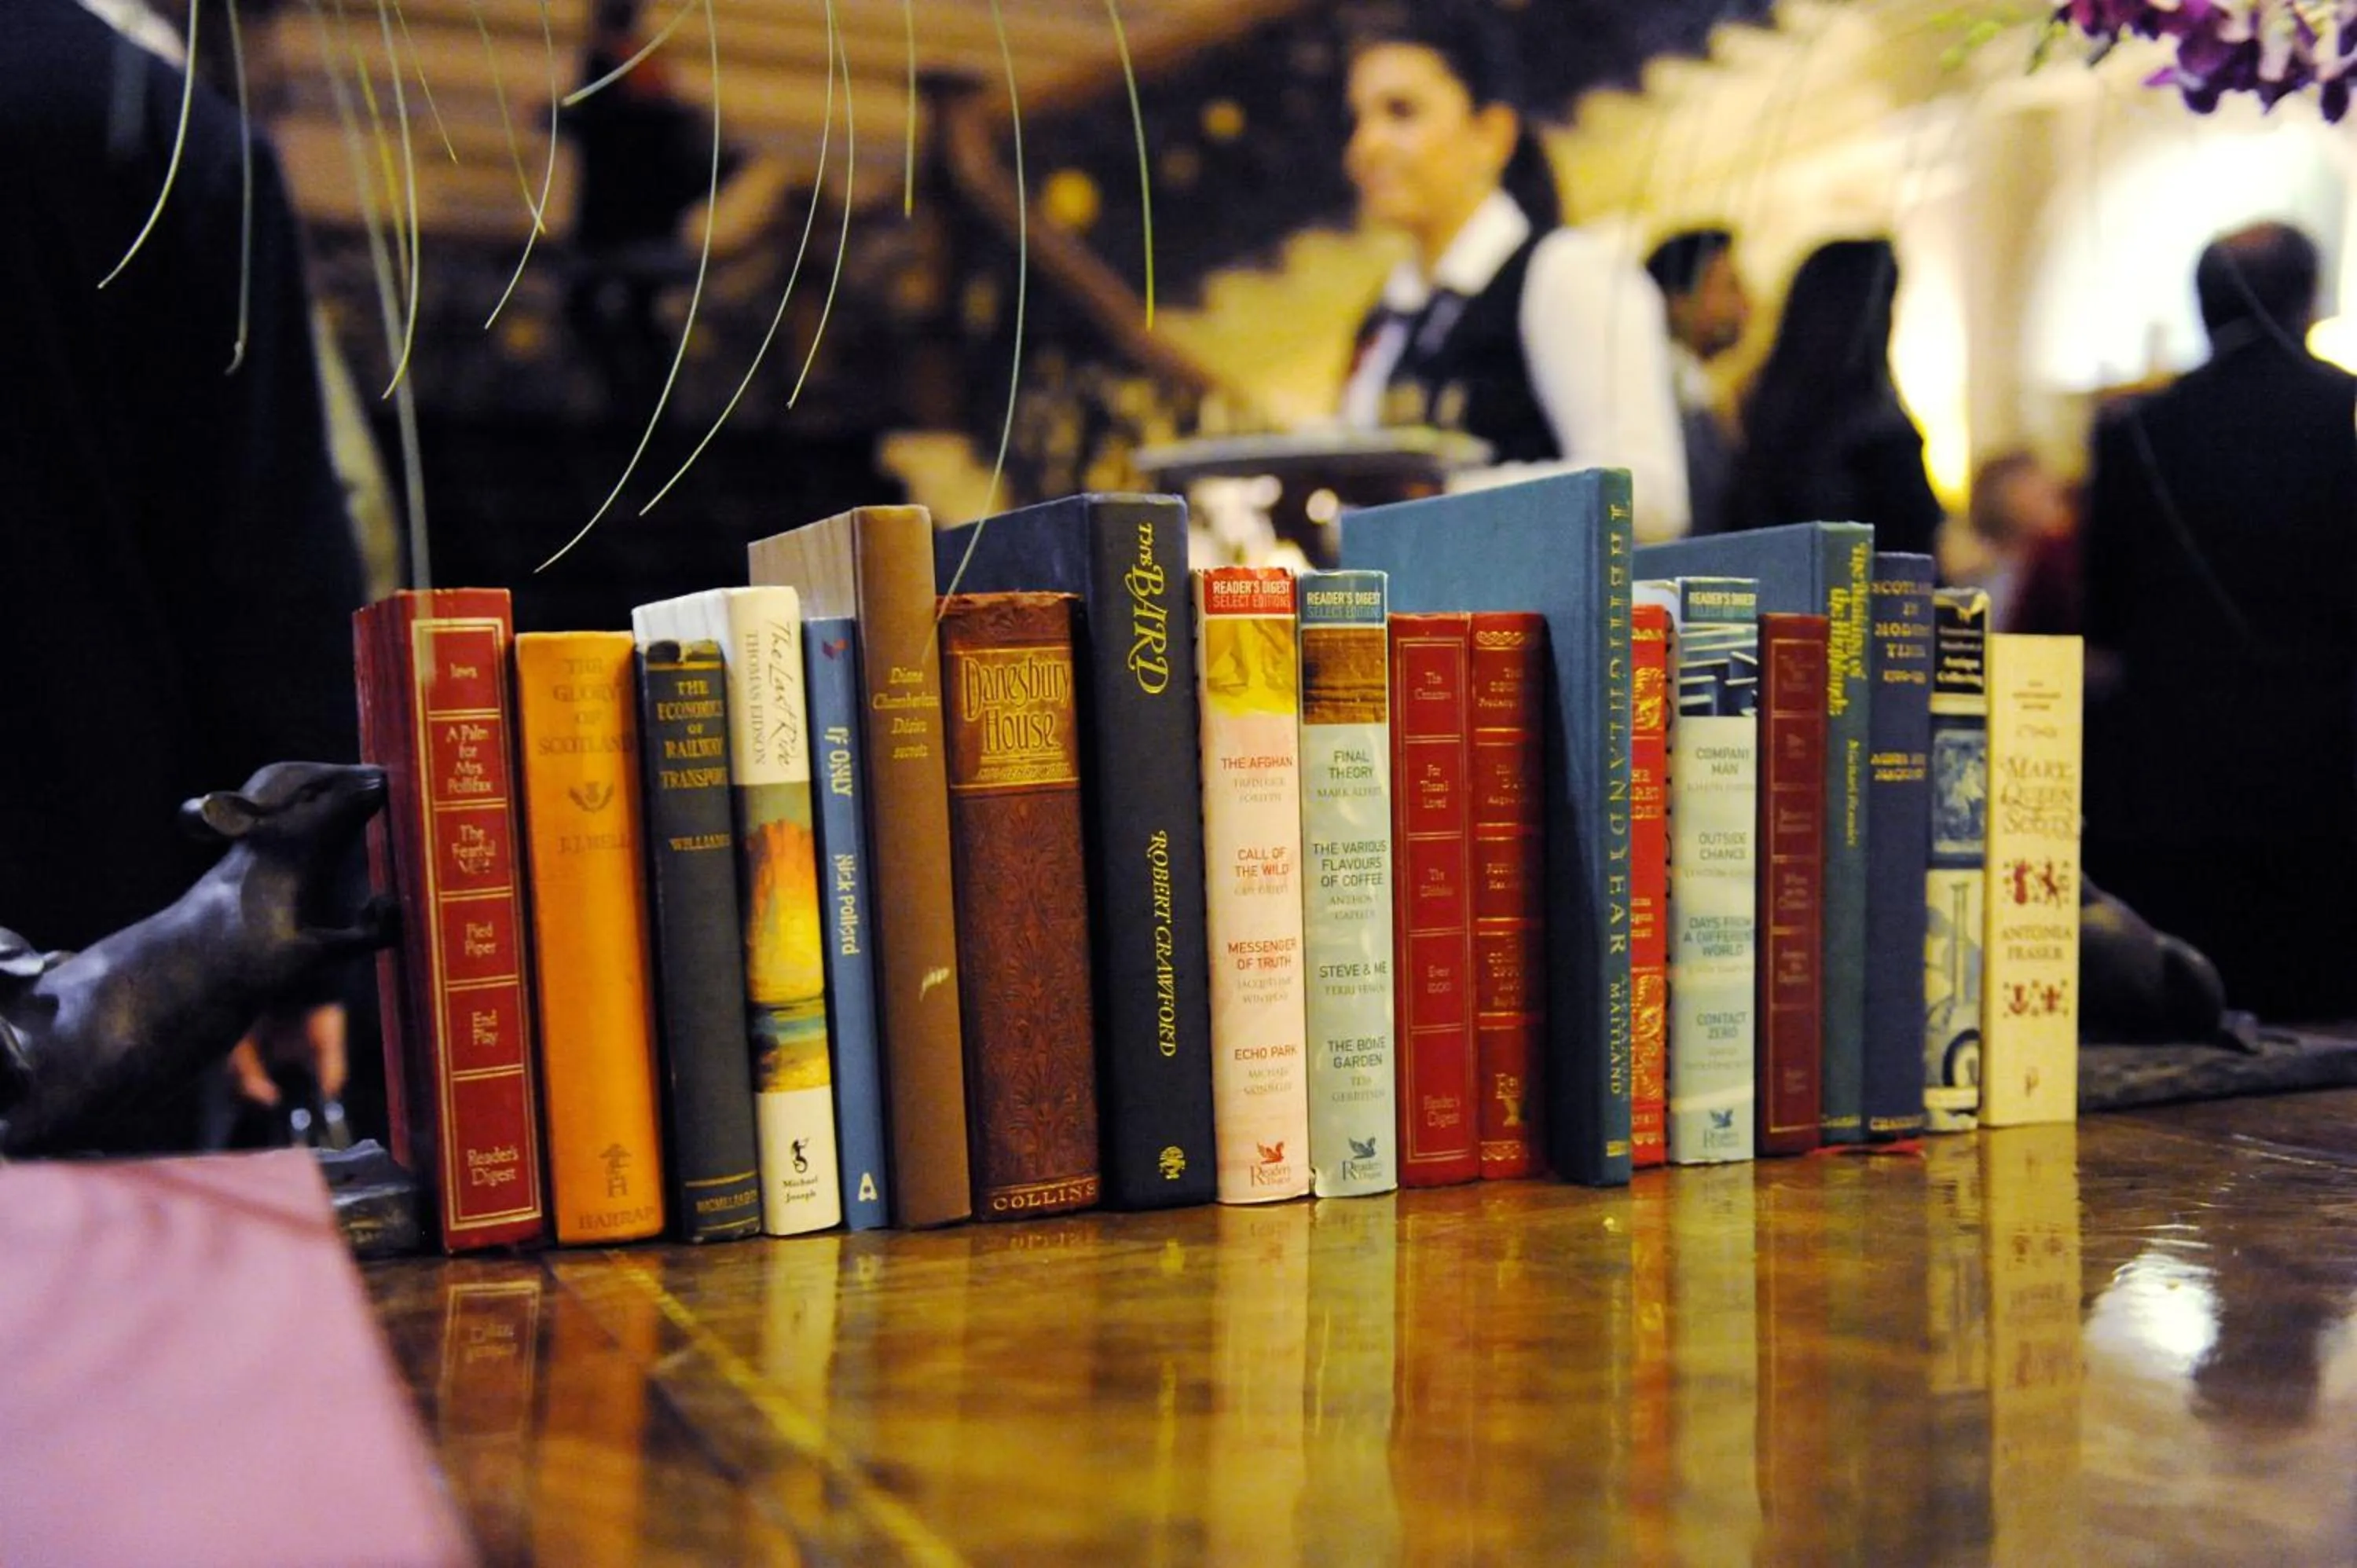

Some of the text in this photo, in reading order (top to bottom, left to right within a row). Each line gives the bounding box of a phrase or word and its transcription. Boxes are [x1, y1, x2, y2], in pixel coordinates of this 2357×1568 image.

[1212, 580, 1290, 594] READER'S DIGEST
[1213, 594, 1291, 608] SELECT EDITIONS
[1307, 591, 1381, 605] READER'S DIGEST
[1125, 563, 1169, 694] BARD
[745, 629, 763, 702] THOMAS
[676, 680, 709, 695] THE
[962, 654, 1071, 721] Danesbury
[446, 724, 489, 743] A Palm
[982, 706, 1061, 754] House
[459, 740, 478, 759] for
[665, 737, 723, 759] RAILWAY
[1221, 756, 1293, 770] THE AFGHAN
[1334, 750, 1369, 764] FINAL
[830, 749, 853, 797] ONLY
[1329, 766, 1373, 780] THEORY
[460, 825, 484, 842] The
[1699, 833, 1747, 845] OUTSIDE
[1237, 846, 1287, 861] CALL OF
[1314, 840, 1387, 855] THE VARIOUS
[834, 853, 856, 892] Nick
[1235, 863, 1290, 878] THE WILD
[1321, 857, 1382, 872] FLAVOURS
[1321, 873, 1384, 888] OF COFFEE
[466, 921, 493, 939] Pied
[1690, 917, 1721, 929] DAYS
[465, 940, 497, 958] Piper
[1147, 830, 1176, 1057] ROBERT CRAWFORD
[1227, 939, 1296, 954] MESSENGER
[2007, 945, 2063, 960] FRASER
[1237, 956, 1292, 971] OF TRUTH
[1319, 961, 1387, 979] STEVE & ME
[1696, 1011, 1748, 1026] CONTACT
[1327, 1035, 1387, 1053] THE BONE
[1610, 983, 1622, 1096] MAITLAND
[1234, 1045, 1297, 1061] ECHO PARK
[1333, 1053, 1383, 1069] GARDEN
[467, 1145, 519, 1167] Reader's
[472, 1167, 516, 1186] Digest
[783, 1176, 819, 1189] Michael
[786, 1189, 816, 1203] Joseph
[993, 1181, 1097, 1211] COLLINS
